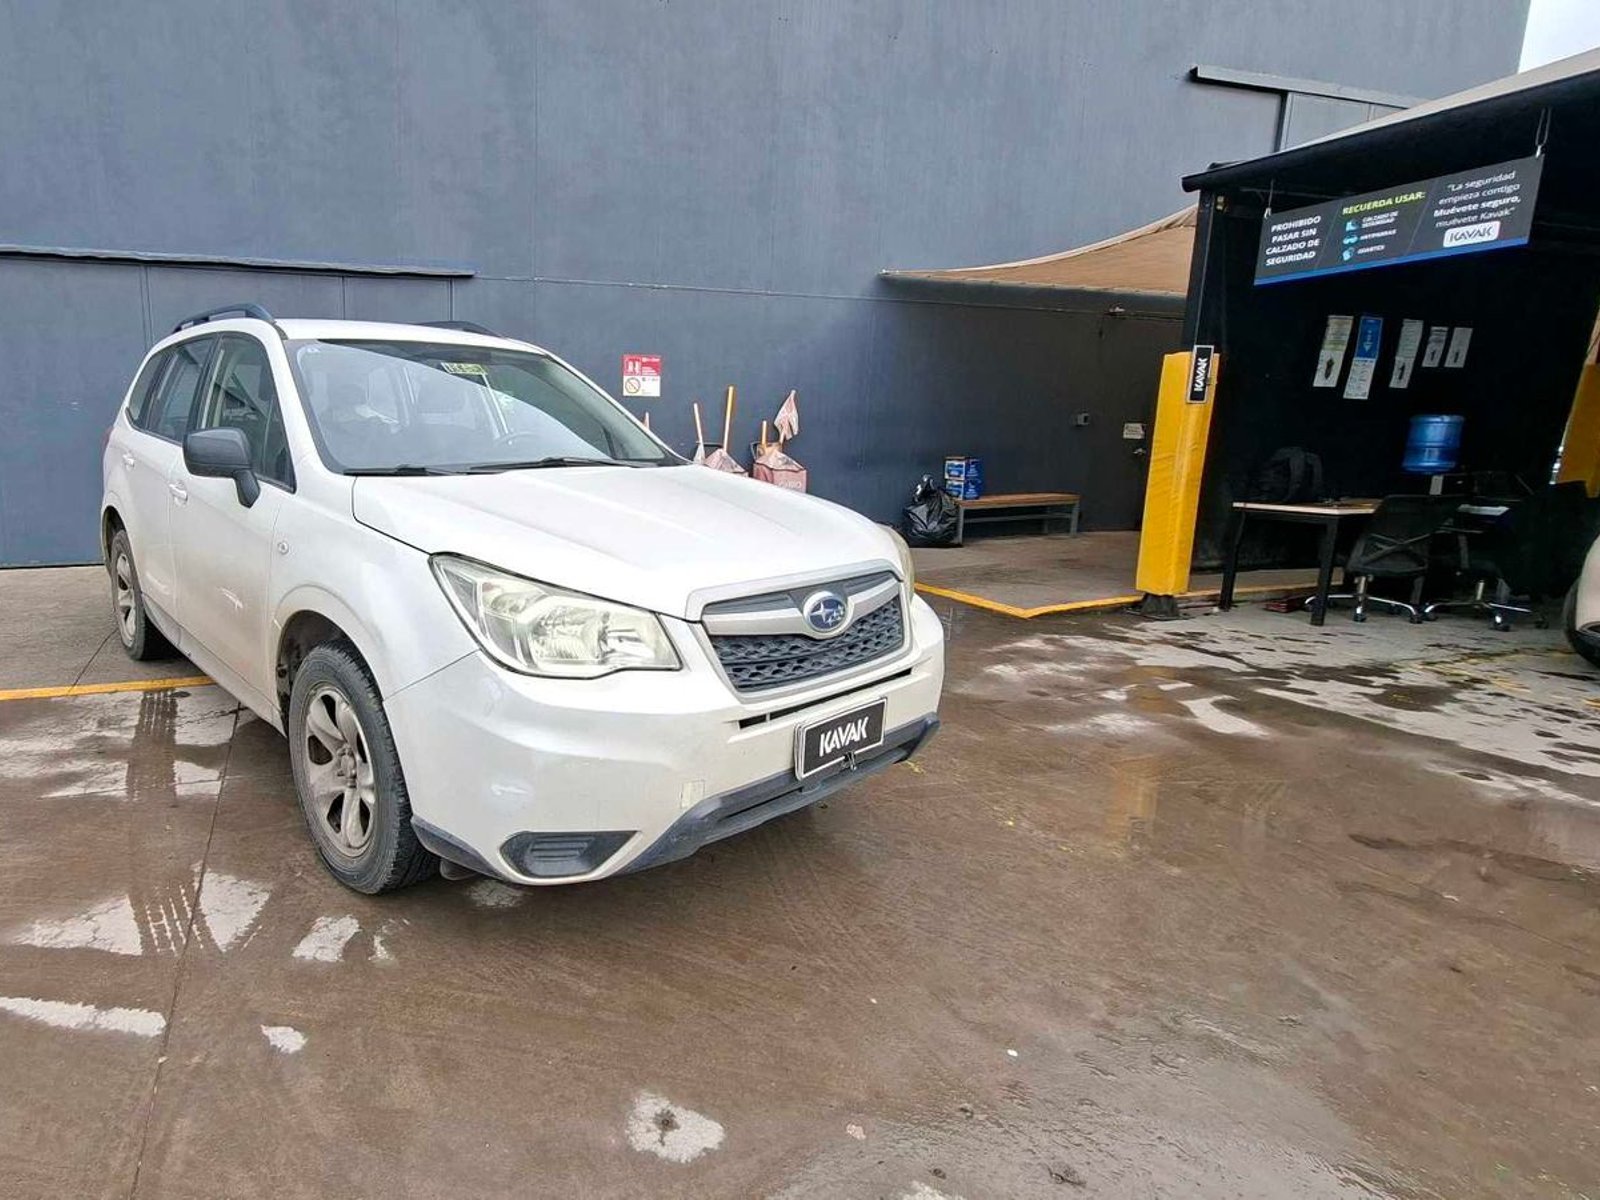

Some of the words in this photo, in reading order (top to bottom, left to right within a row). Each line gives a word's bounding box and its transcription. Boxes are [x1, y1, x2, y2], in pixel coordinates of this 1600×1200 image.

[1465, 170, 1516, 189] seguridad
[1342, 198, 1394, 215] RECUERDA
[1395, 191, 1427, 204] USAR:
[1438, 191, 1480, 205] empieza
[1482, 183, 1521, 197] contigo
[1433, 203, 1479, 218] Muévete
[1480, 195, 1521, 209] seguro,
[1271, 215, 1321, 233] PROHIBIDO
[1435, 214, 1478, 228] muévete
[1271, 231, 1300, 243] PASAR
[1300, 228, 1317, 238] SIN
[1449, 225, 1493, 242] KAVAK
[1265, 241, 1306, 255] CALZADO
[1307, 238, 1321, 246] DE
[1265, 251, 1316, 266] SEGURIDAD
[1193, 357, 1208, 392] KAVAK
[818, 716, 869, 757] KAVAK
